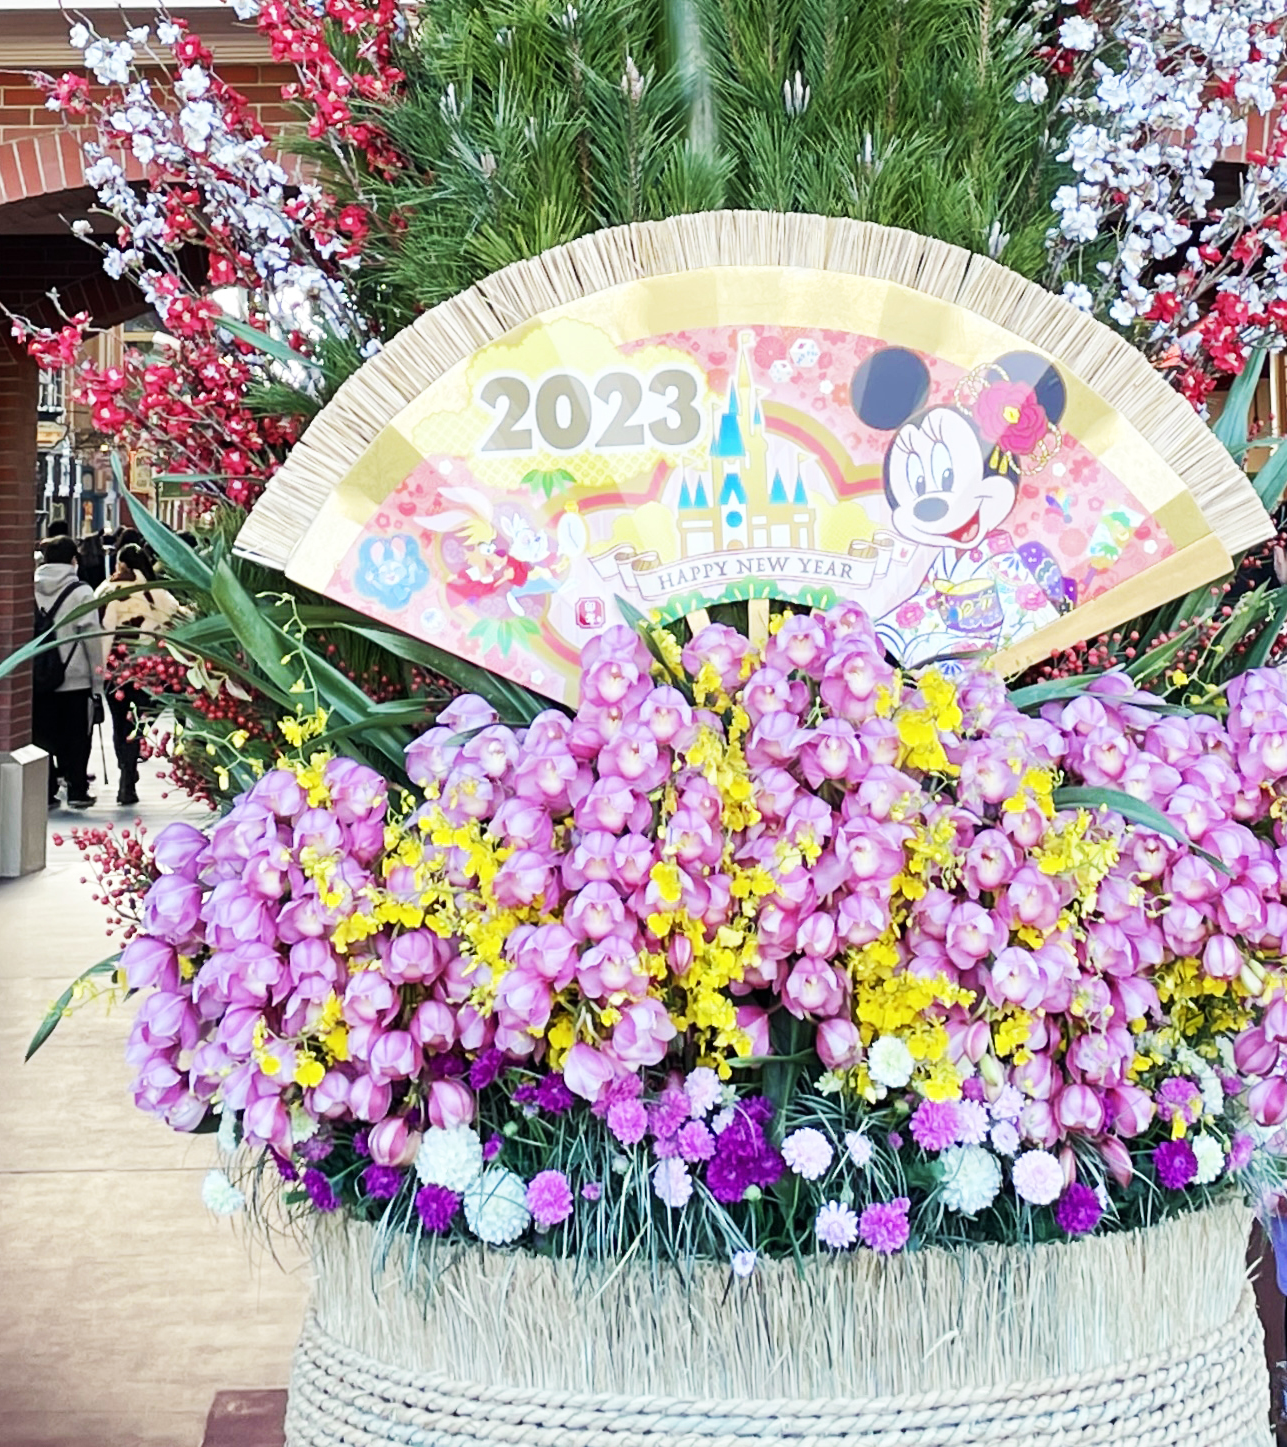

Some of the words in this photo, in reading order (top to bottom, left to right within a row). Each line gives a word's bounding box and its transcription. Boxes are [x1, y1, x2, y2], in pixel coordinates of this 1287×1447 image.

[480, 368, 701, 452] 2023
[657, 560, 729, 590] HAPPY
[736, 556, 790, 575] NEW
[797, 557, 853, 579] YEAR
